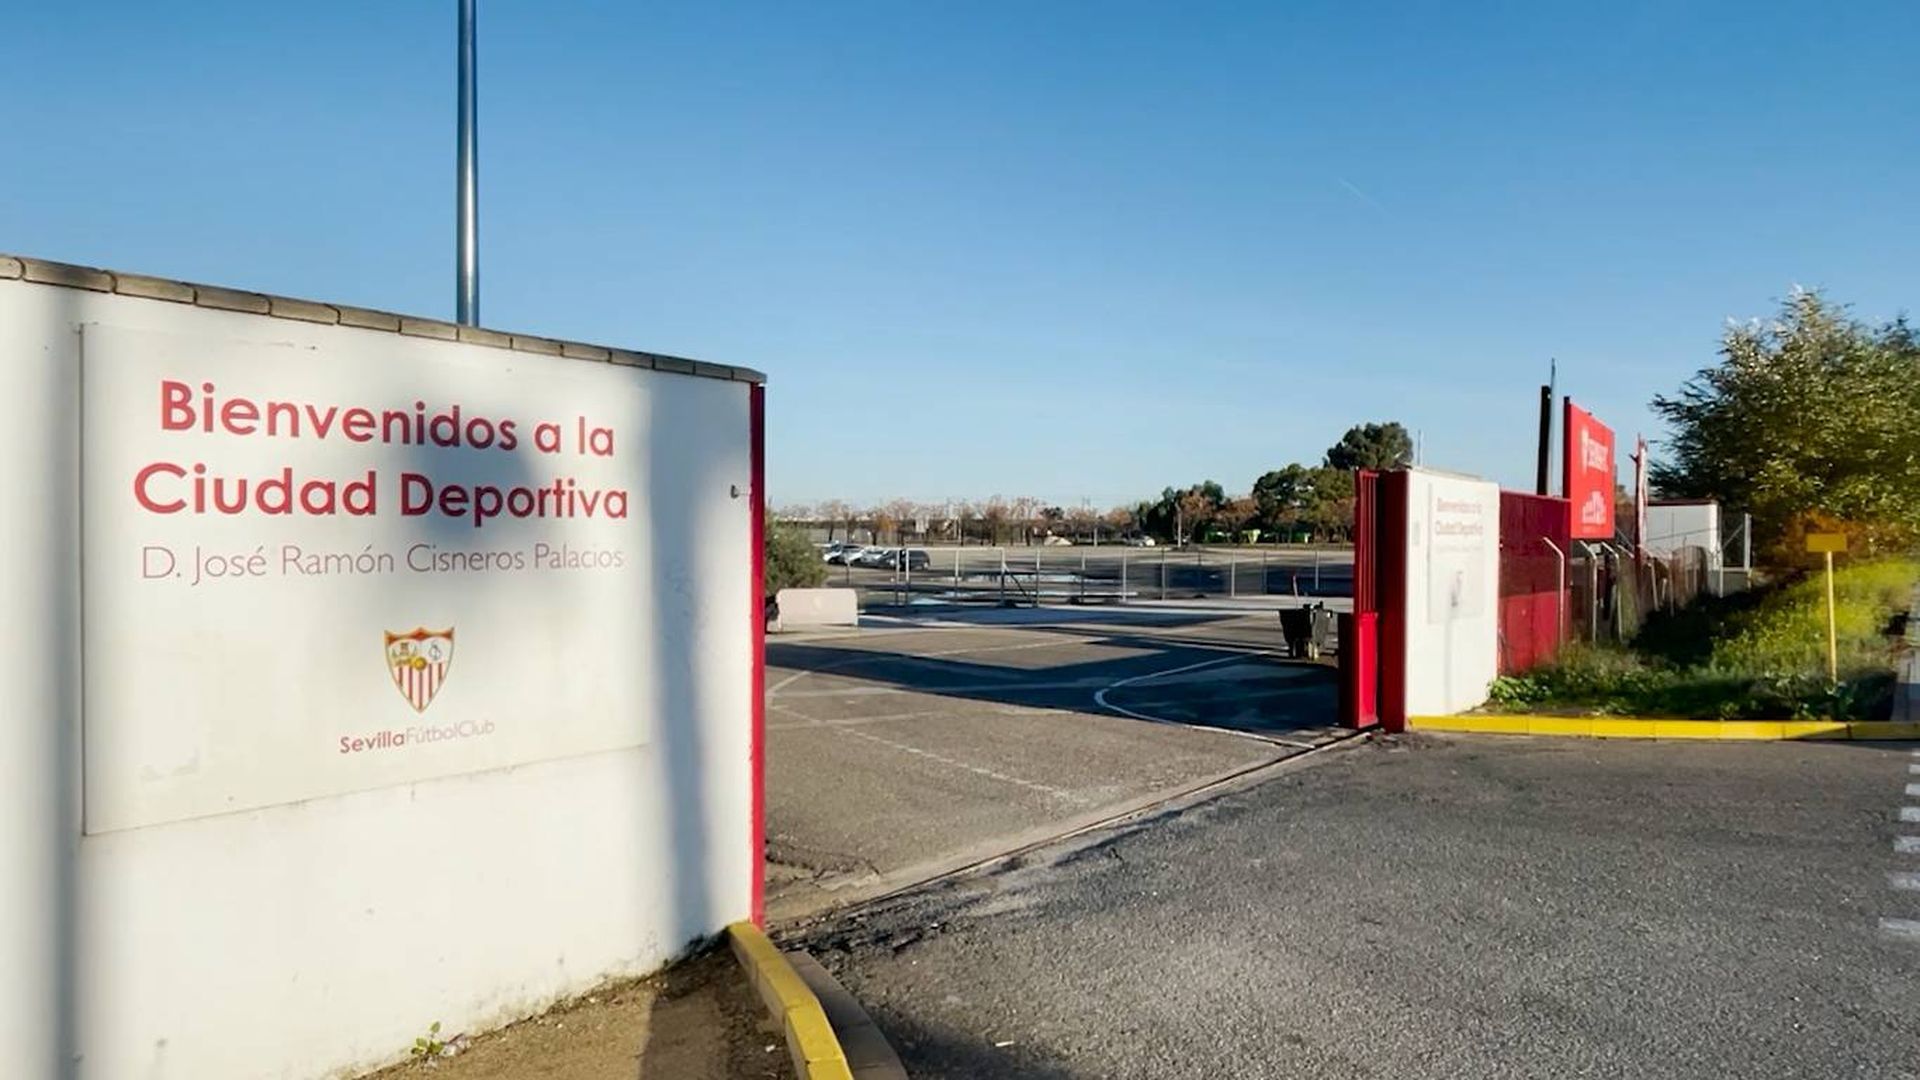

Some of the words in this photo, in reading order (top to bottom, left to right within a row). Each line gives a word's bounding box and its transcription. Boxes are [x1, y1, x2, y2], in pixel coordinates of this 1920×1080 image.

[158, 378, 517, 453] Bienvenidos
[532, 420, 562, 454] a
[577, 415, 616, 457] la
[132, 461, 378, 517] Ciudad
[399, 471, 629, 528] Deportiva
[142, 545, 181, 579] D.
[191, 545, 267, 586] José
[281, 543, 395, 576] Ramón
[406, 543, 526, 573] Cisneros
[533, 543, 625, 569] Palacios
